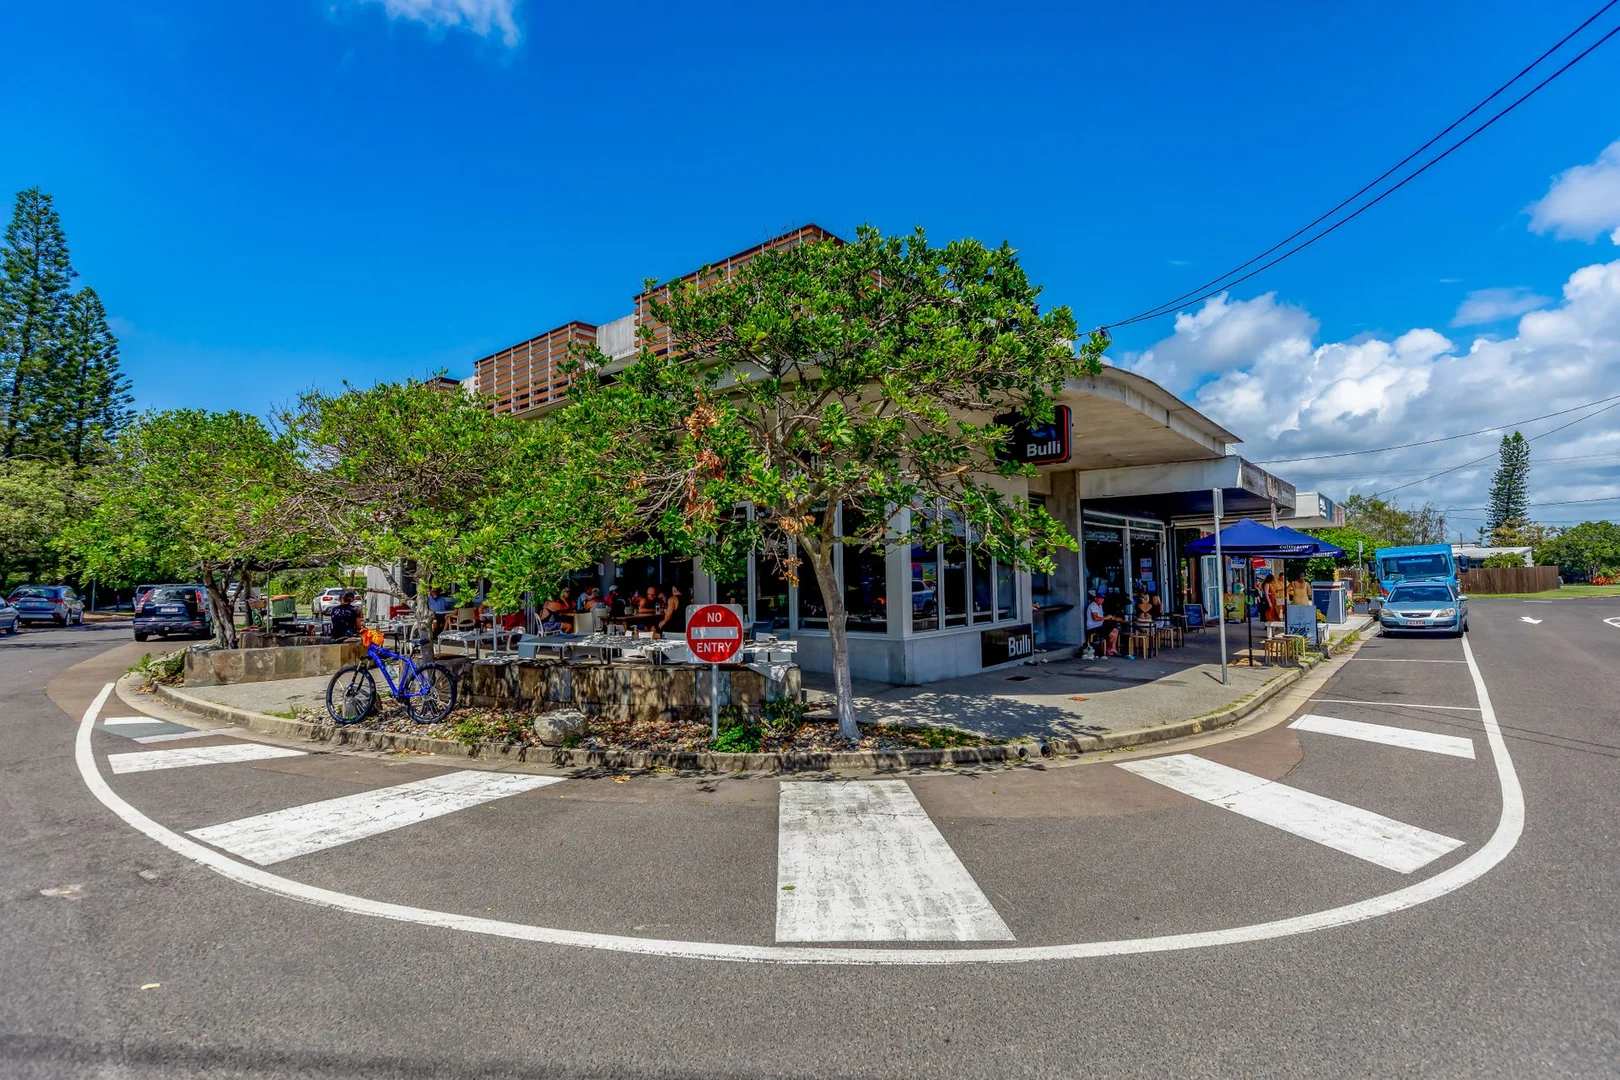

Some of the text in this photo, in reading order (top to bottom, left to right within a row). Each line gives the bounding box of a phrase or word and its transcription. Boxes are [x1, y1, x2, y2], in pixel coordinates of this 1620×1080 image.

[1026, 440, 1061, 457] Bulli
[707, 612, 722, 623] NO
[696, 642, 732, 653] ENTRY
[1008, 632, 1031, 658] Bulli
